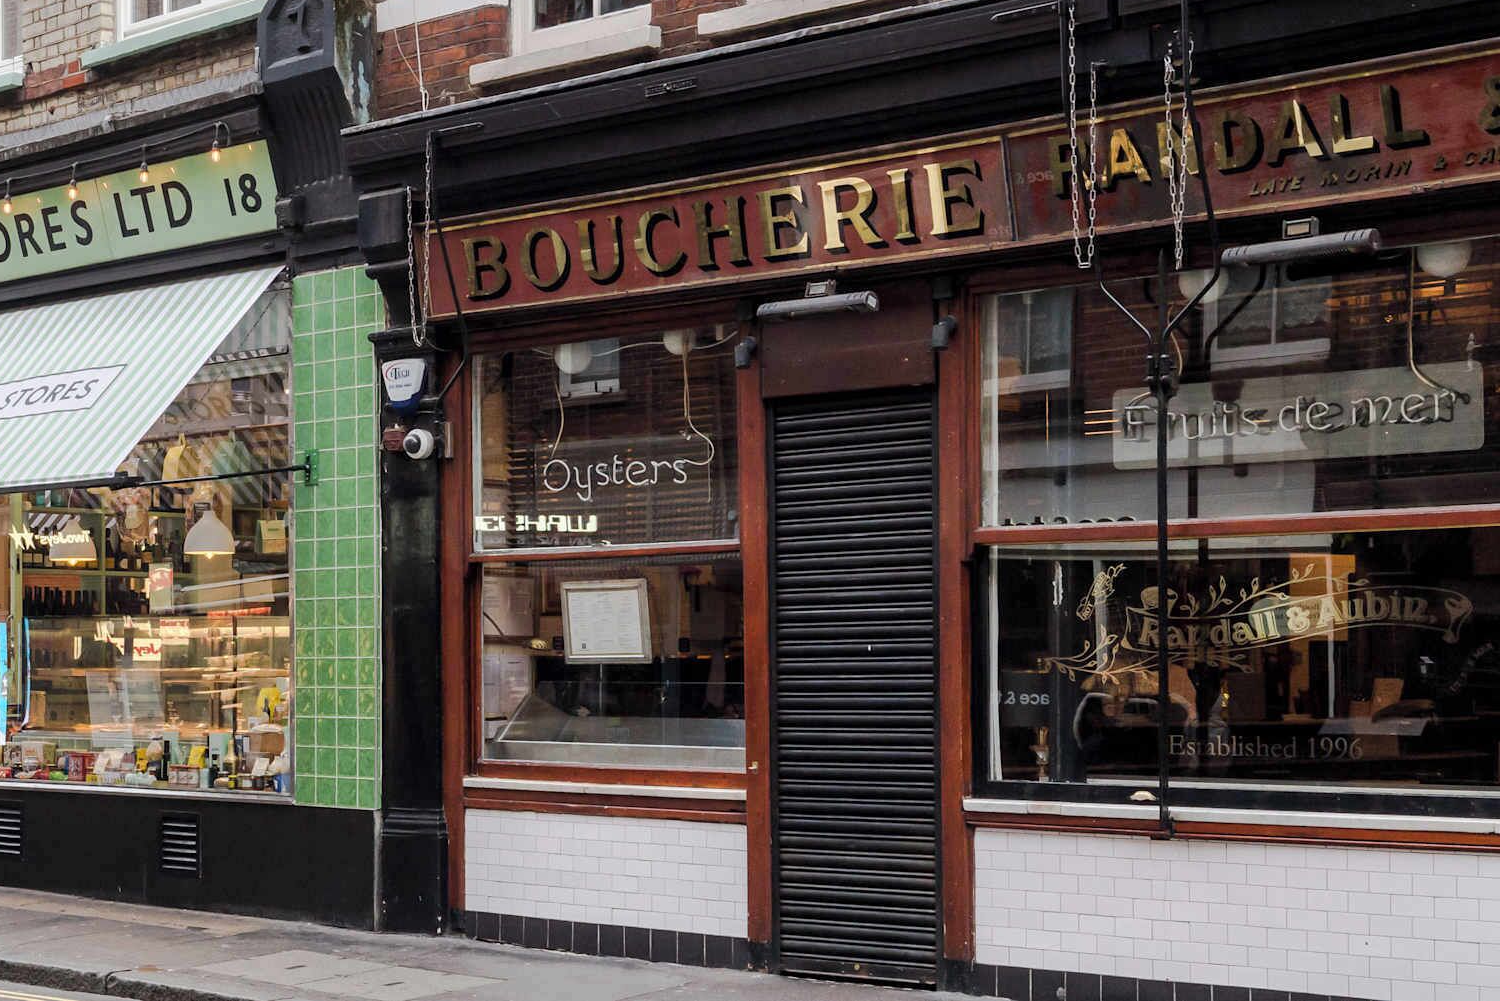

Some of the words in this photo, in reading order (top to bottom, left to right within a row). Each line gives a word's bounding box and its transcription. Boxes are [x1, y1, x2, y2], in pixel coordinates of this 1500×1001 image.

[1047, 84, 1430, 199] RANDALL
[1249, 175, 1305, 197] LATE
[1464, 147, 1500, 167] CA
[113, 180, 193, 237] LTD
[223, 173, 262, 217] 18
[460, 158, 984, 300] BOUCHERIE
[543, 454, 688, 501] Oysters
[1286, 606, 1310, 633] &
[1168, 734, 1297, 760] Esablished
[1308, 735, 1364, 760] 1996
